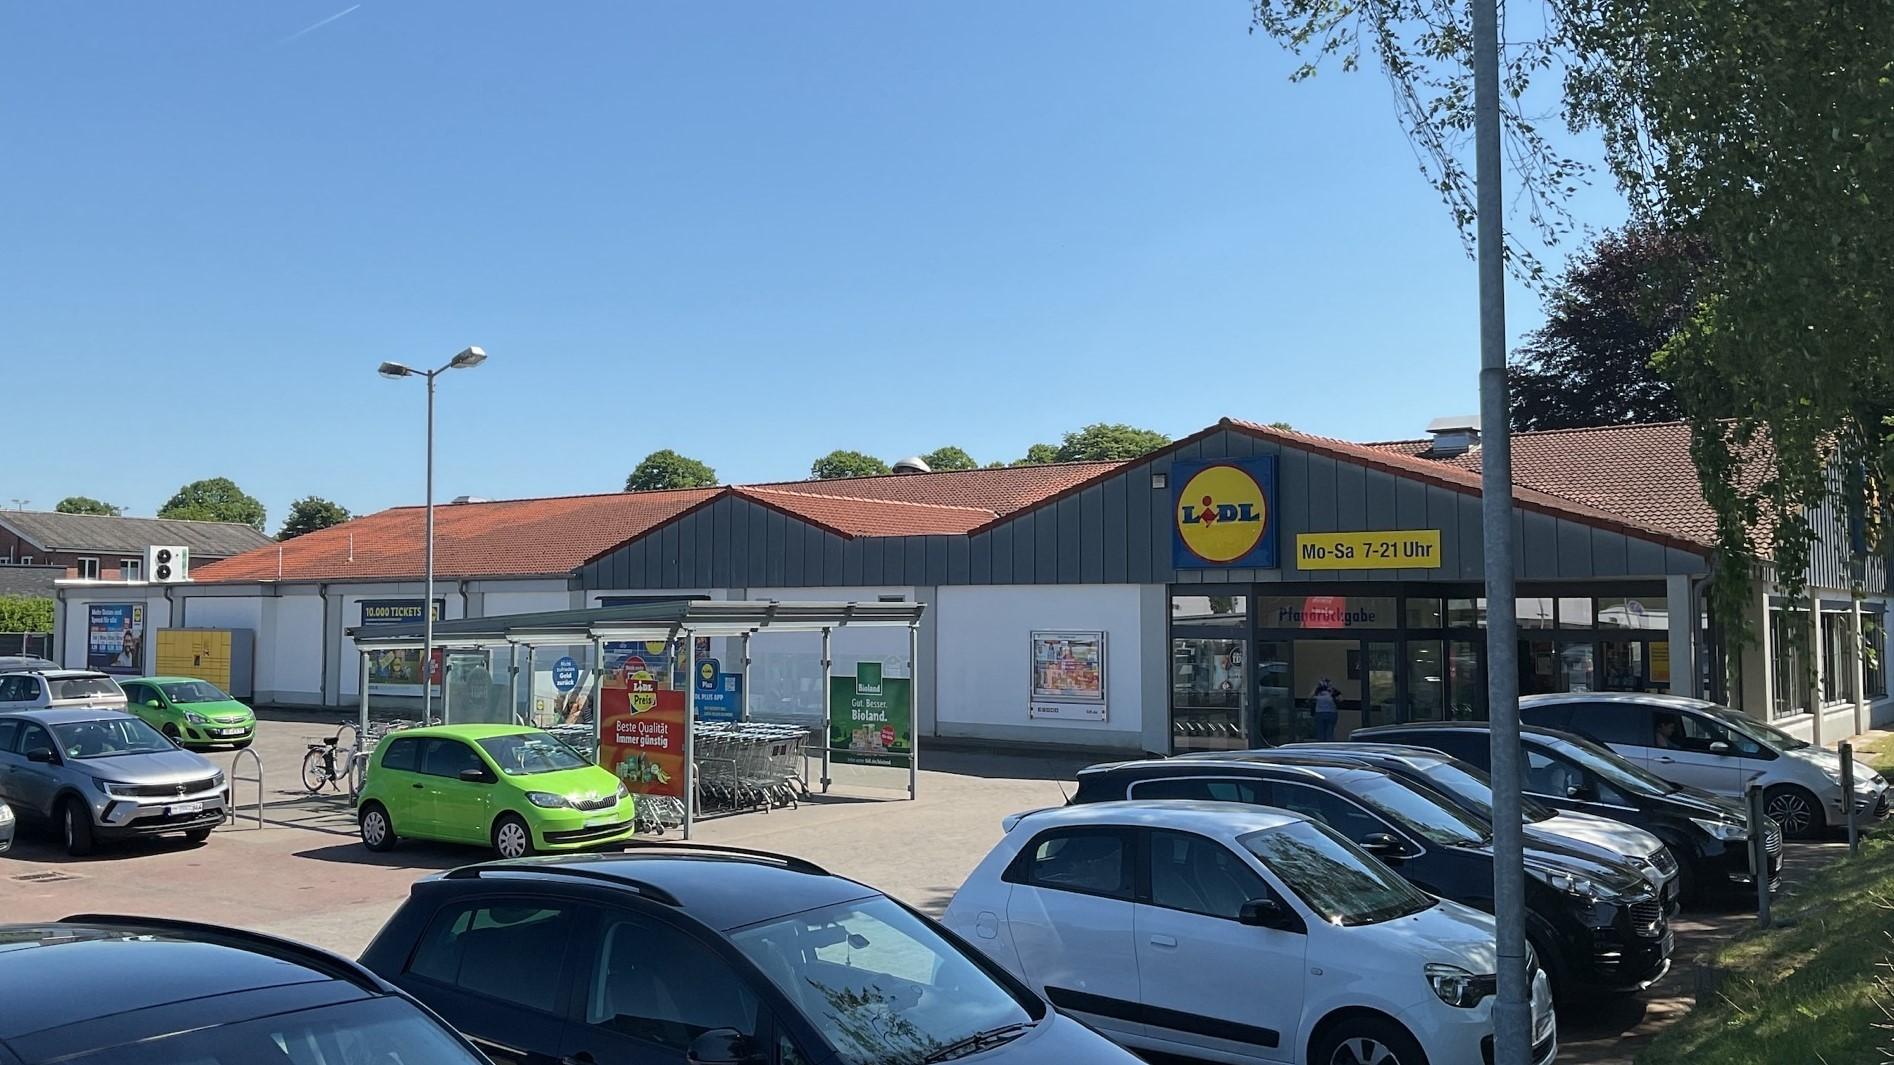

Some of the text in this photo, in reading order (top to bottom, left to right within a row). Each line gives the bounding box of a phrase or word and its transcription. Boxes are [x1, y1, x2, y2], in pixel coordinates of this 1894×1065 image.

[1302, 541, 1433, 560] Mo-Sa 7-21 Uhr
[366, 606, 422, 617] 10.000 TICKETS
[701, 681, 713, 689] Plus
[858, 683, 881, 693] Bioland
[633, 694, 652, 706] Preis
[701, 693, 713, 701] PLUS
[865, 699, 888, 709] Besser.
[852, 709, 888, 721] Bioland.
[616, 720, 668, 736] Beste Qualität
[616, 732, 668, 748] Immer günstig
